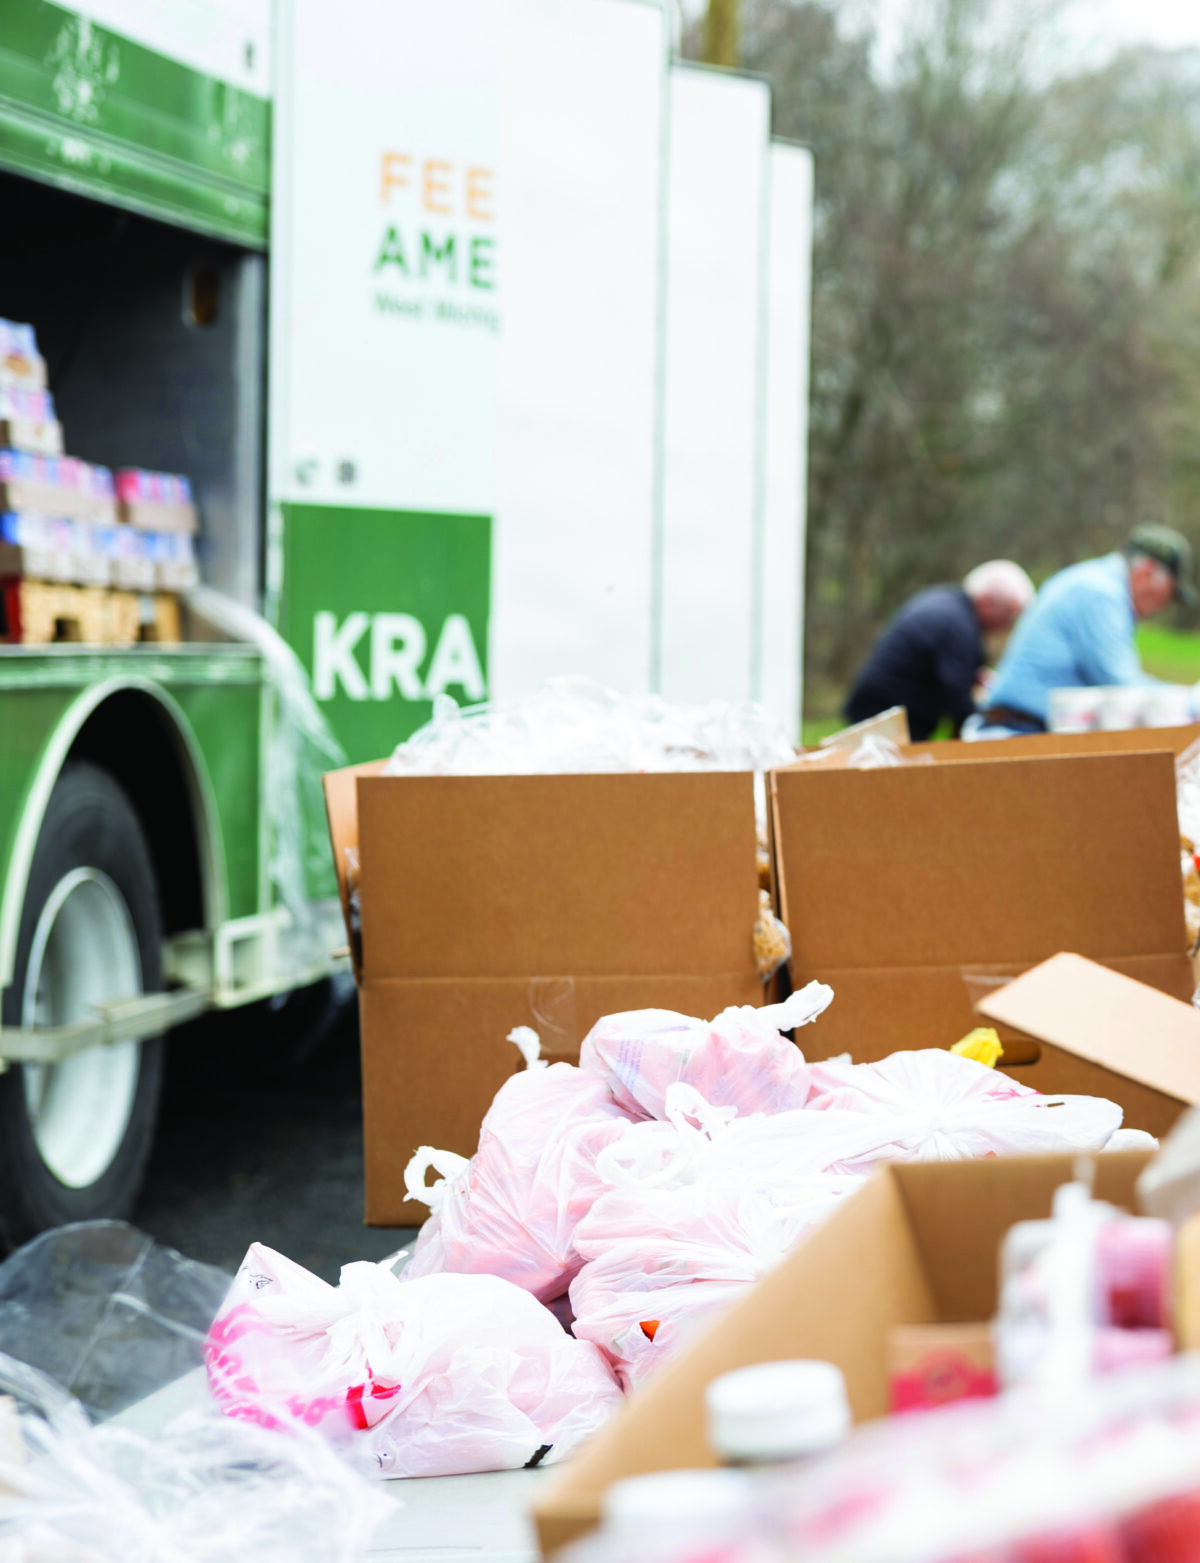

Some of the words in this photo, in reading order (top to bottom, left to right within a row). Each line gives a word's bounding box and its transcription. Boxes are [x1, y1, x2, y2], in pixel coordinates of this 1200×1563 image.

[379, 152, 495, 220] FEE
[374, 224, 496, 290] AME
[312, 610, 488, 702] KRA
